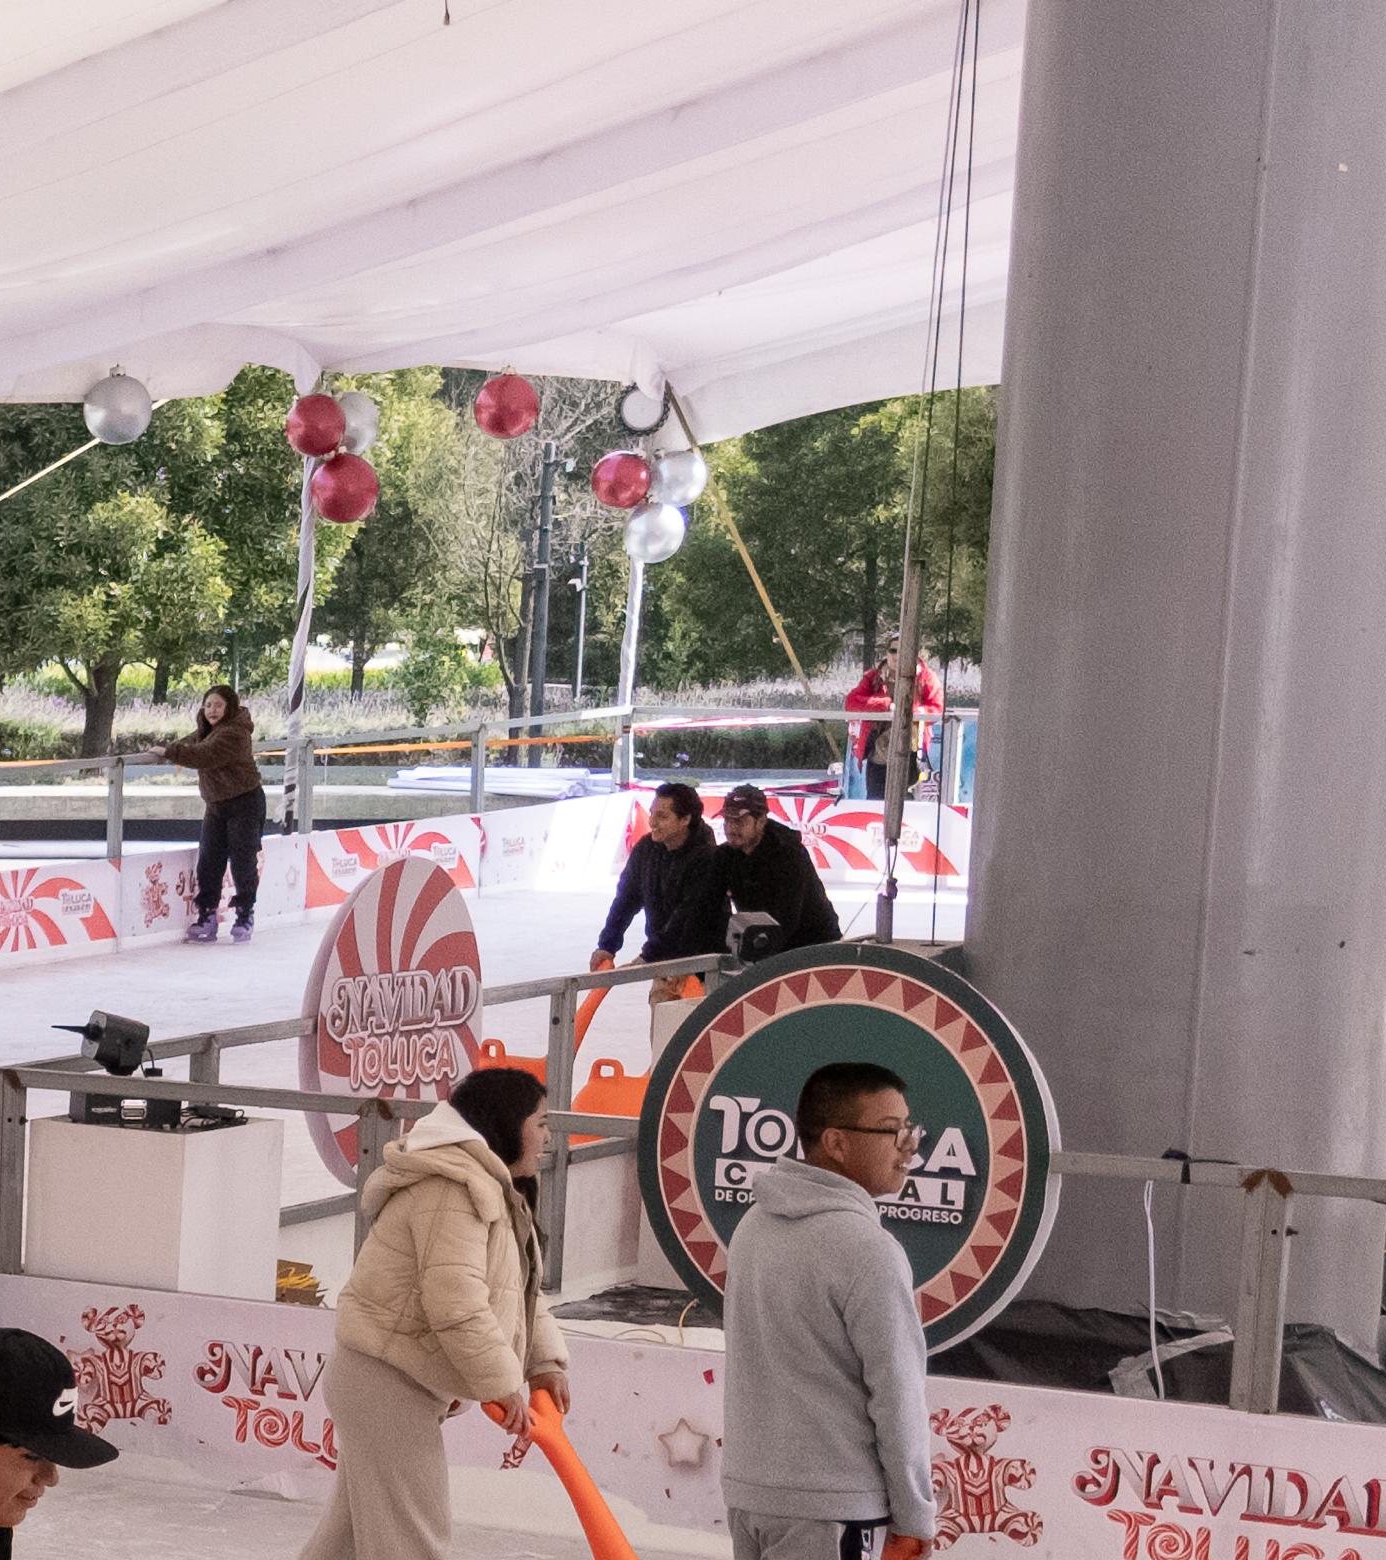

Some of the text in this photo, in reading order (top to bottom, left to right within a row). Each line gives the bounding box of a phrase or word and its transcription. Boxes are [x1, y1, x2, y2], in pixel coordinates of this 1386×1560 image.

[327, 966, 479, 1041] NAVIDAD
[343, 1030, 458, 1089] TOLUCA
[715, 1189, 733, 1202] DE
[877, 1205, 963, 1225] PROGRESO
